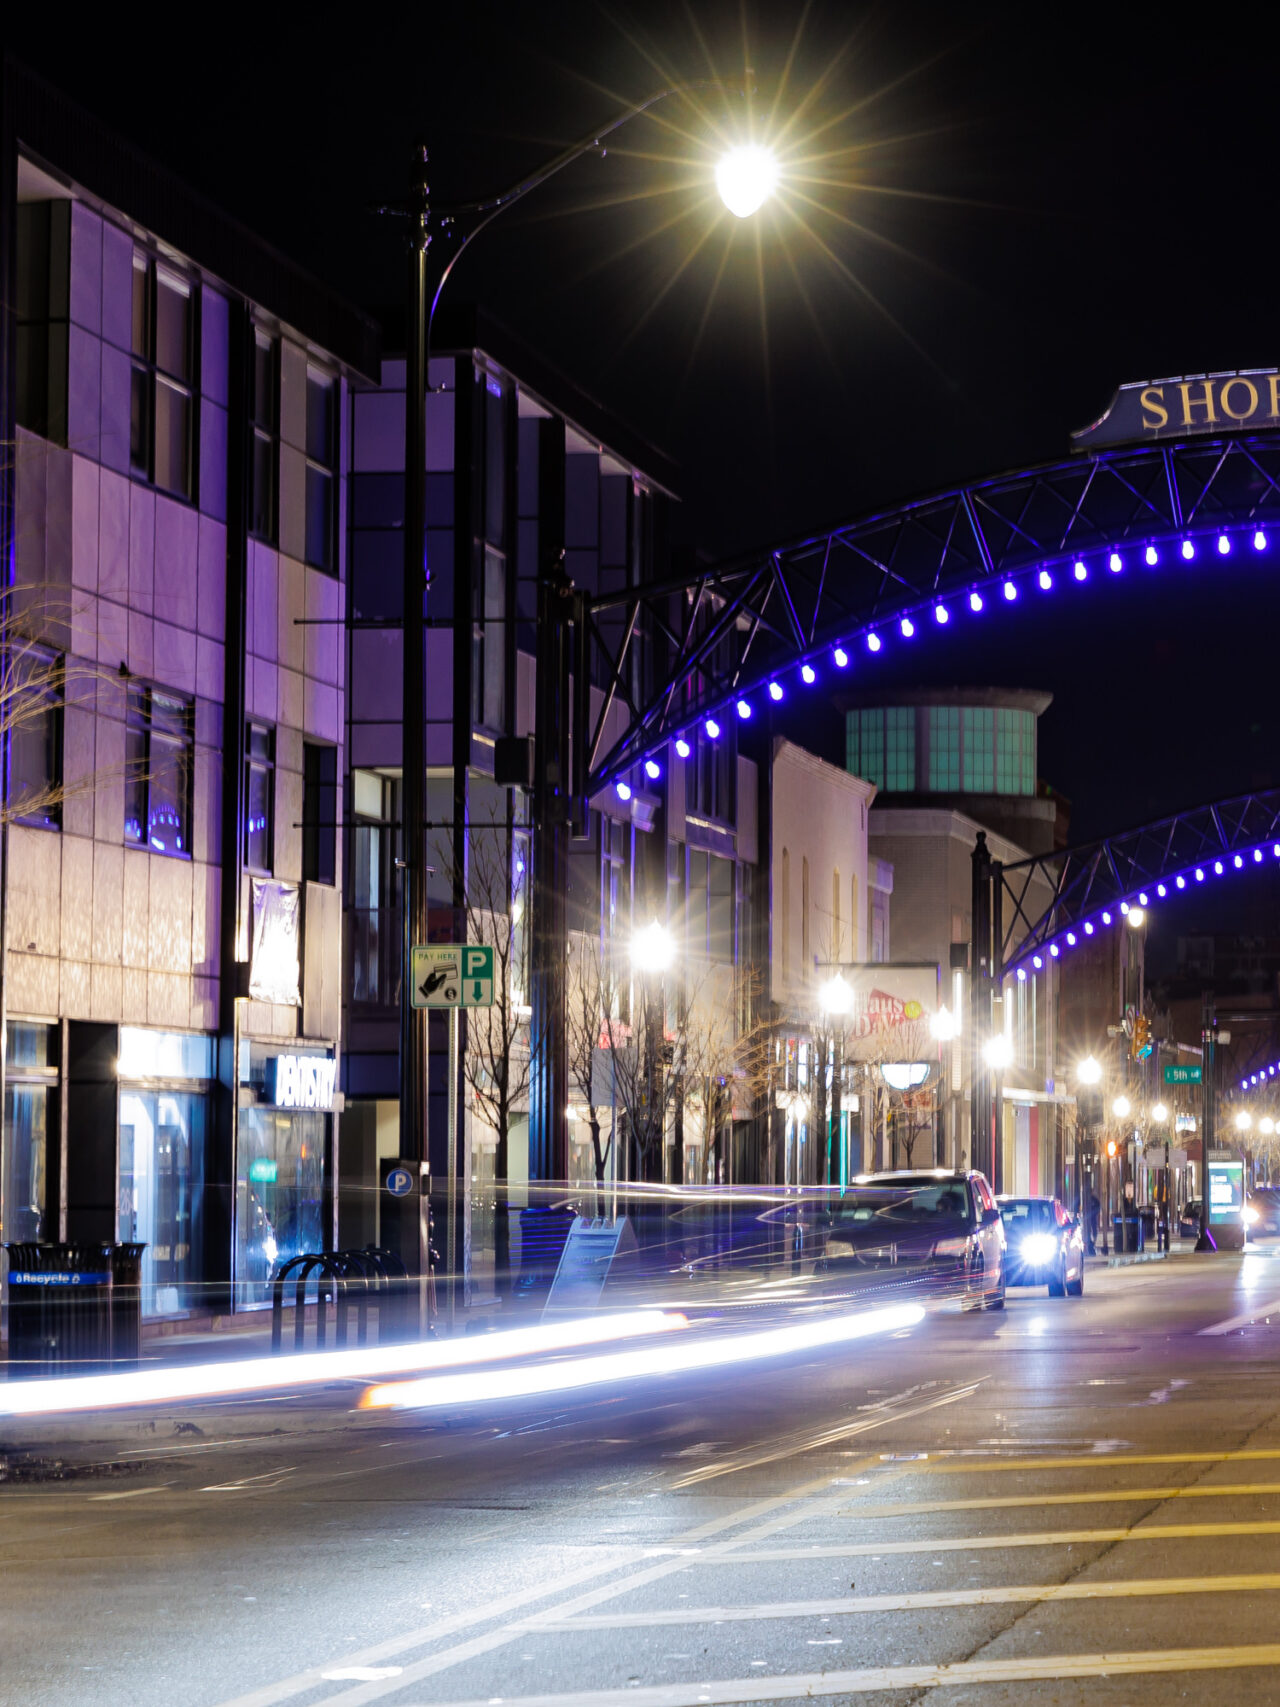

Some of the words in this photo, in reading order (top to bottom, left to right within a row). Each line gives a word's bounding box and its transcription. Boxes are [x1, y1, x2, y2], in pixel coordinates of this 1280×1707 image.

[467, 951, 487, 976] P
[276, 1055, 336, 1108] DENTISTRY
[1173, 1069, 1188, 1080] 5th
[395, 1172, 407, 1192] P
[23, 1274, 69, 1285] Recycle
